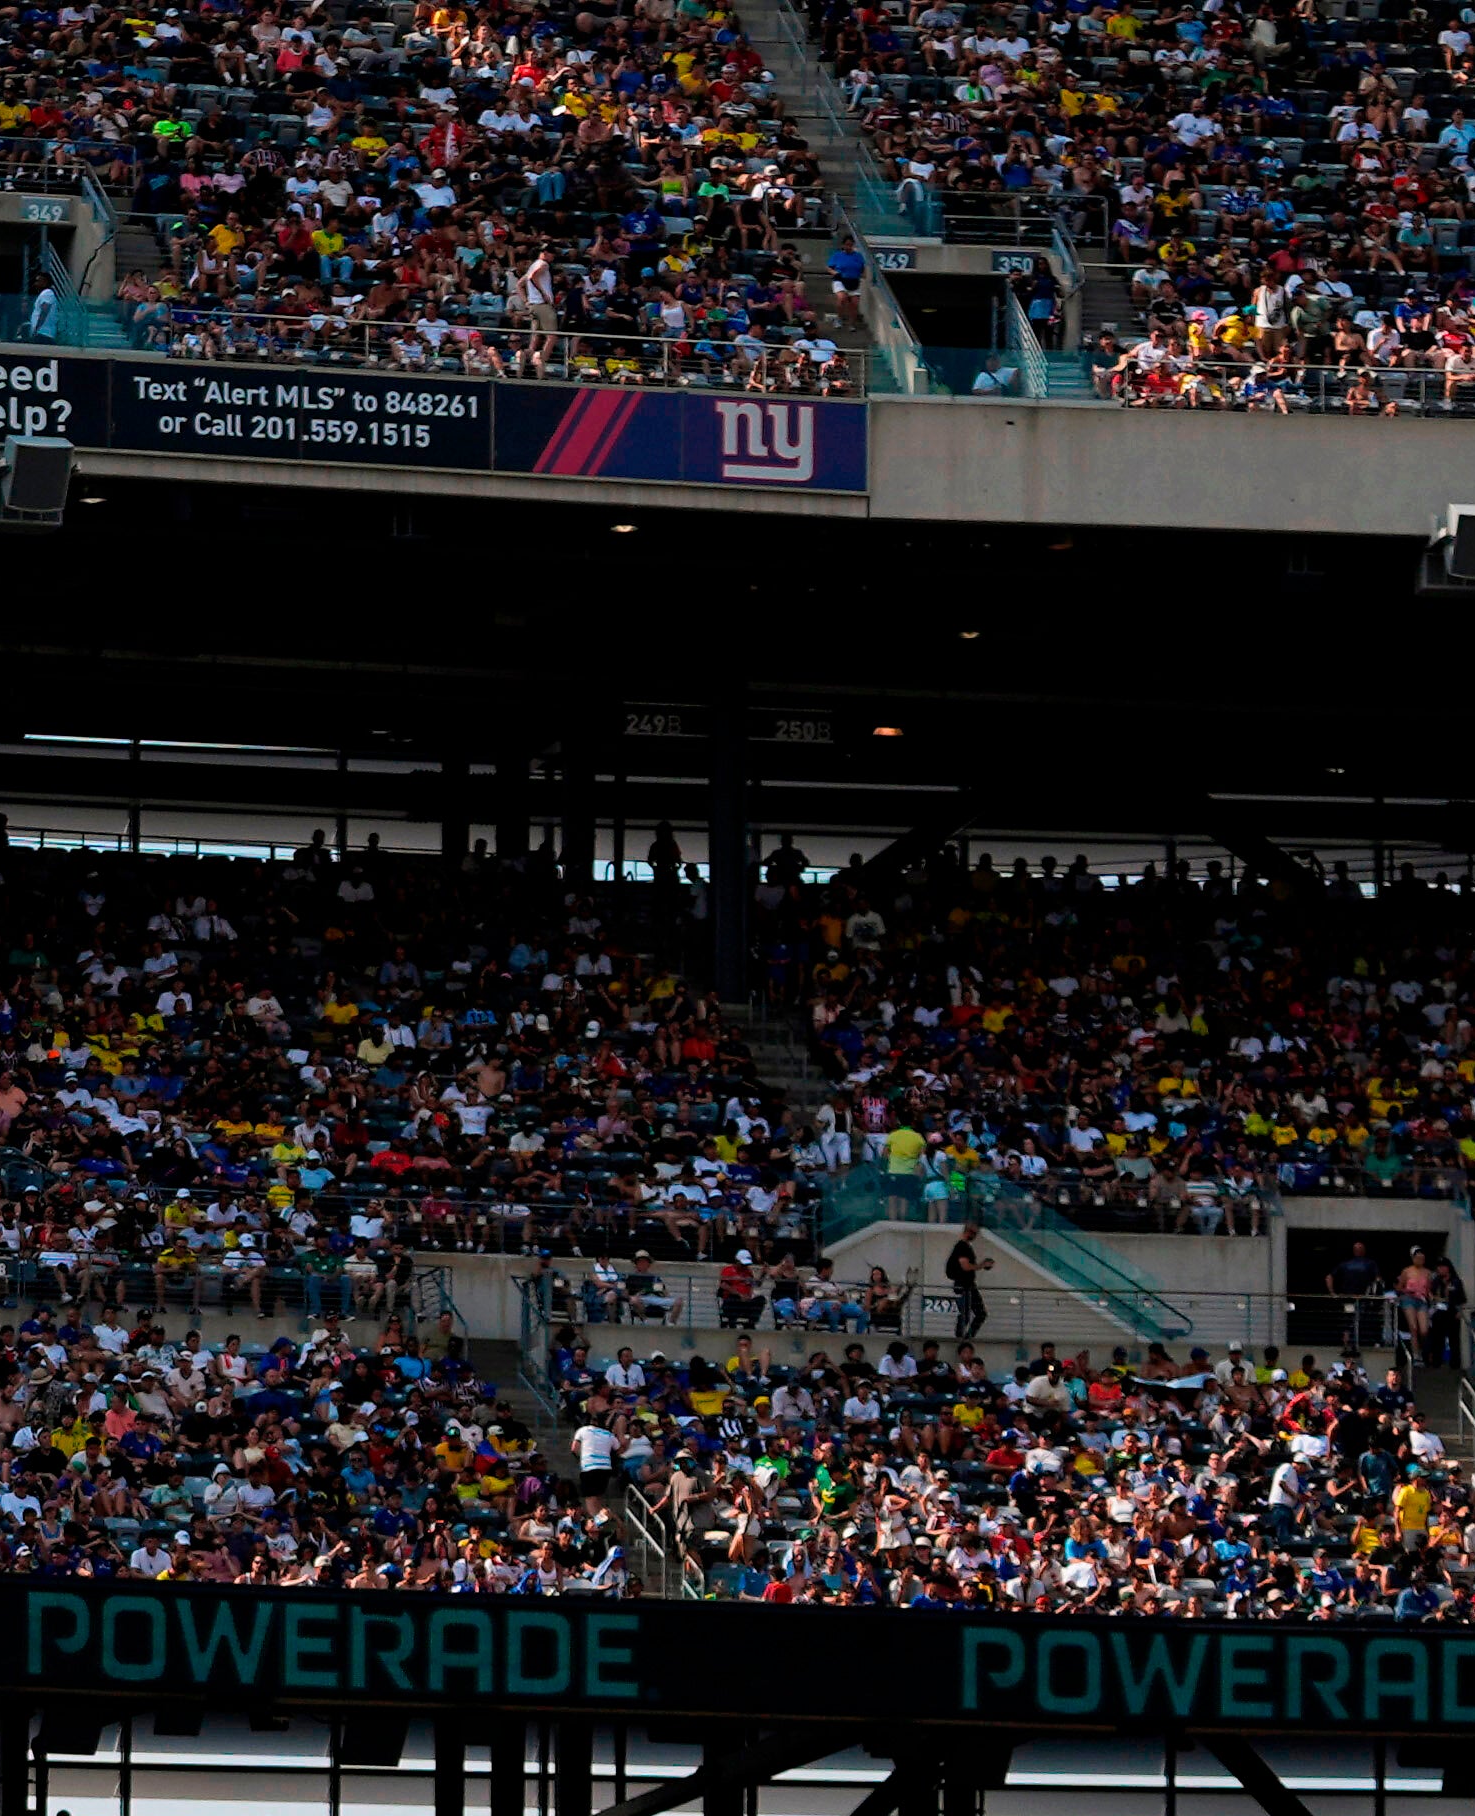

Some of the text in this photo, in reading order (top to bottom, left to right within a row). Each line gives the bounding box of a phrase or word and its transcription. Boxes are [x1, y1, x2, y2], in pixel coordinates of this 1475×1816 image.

[18, 204, 53, 222] 349
[133, 376, 187, 402] Text
[352, 390, 378, 412] to
[385, 391, 479, 419] 848261
[159, 412, 431, 448] or Call 201.559.1515
[715, 401, 815, 485] ny
[27, 1591, 642, 1699] POWERADE
